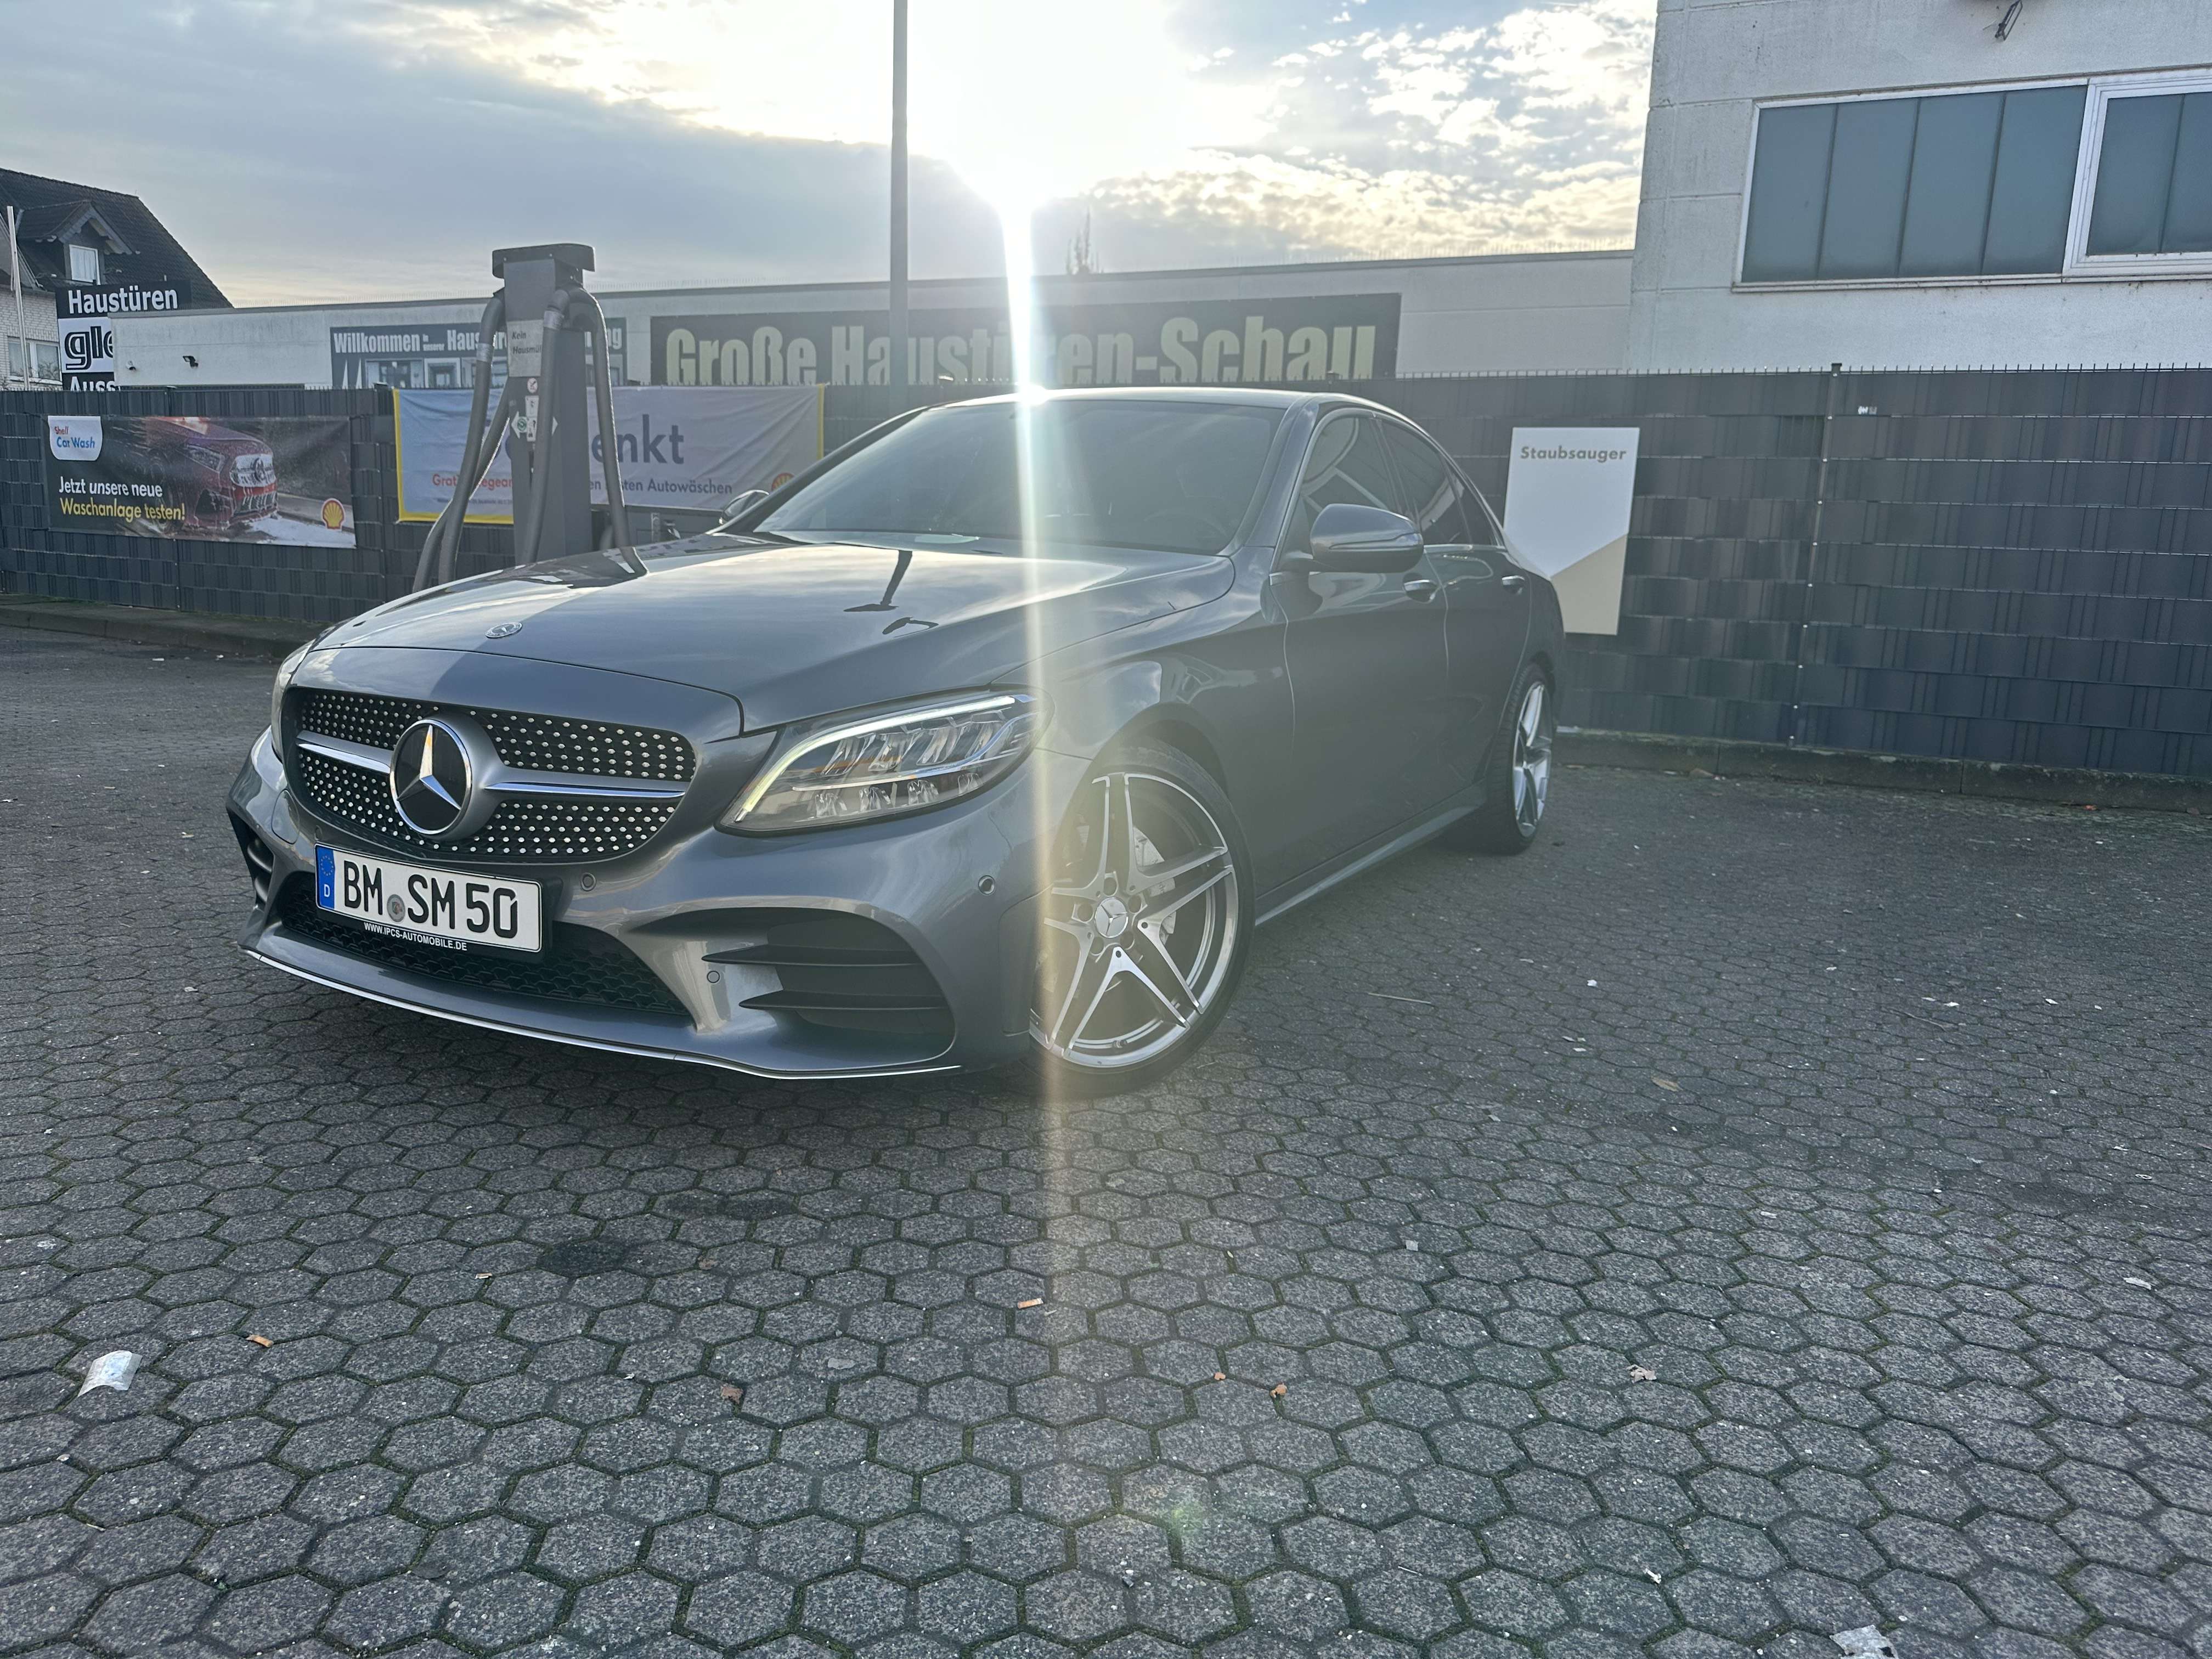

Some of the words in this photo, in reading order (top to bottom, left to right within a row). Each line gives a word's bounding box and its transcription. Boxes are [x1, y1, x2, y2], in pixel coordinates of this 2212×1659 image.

[68, 285, 178, 314] Haustüren
[334, 332, 420, 353] Willkommen
[512, 331, 527, 340] Kein
[512, 346, 542, 354] Hausmül
[666, 326, 817, 385] Große
[54, 426, 69, 435] Shell
[57, 437, 70, 448] Car
[71, 437, 95, 449] Wash
[1521, 445, 1627, 463] Staubsauger
[59, 476, 86, 493] Jetzt
[89, 481, 129, 496] unsere
[131, 484, 163, 497] neue
[432, 473, 458, 487] Grat
[647, 478, 733, 494] Autowäschen
[59, 497, 142, 523] Waschanlage
[144, 503, 185, 521] testen!
[324, 884, 330, 898] D
[343, 860, 383, 915] BM
[408, 874, 456, 929] SM
[466, 882, 518, 939] 50
[364, 922, 467, 951] WWW.IPCS-AUTOMOBILE.DE
